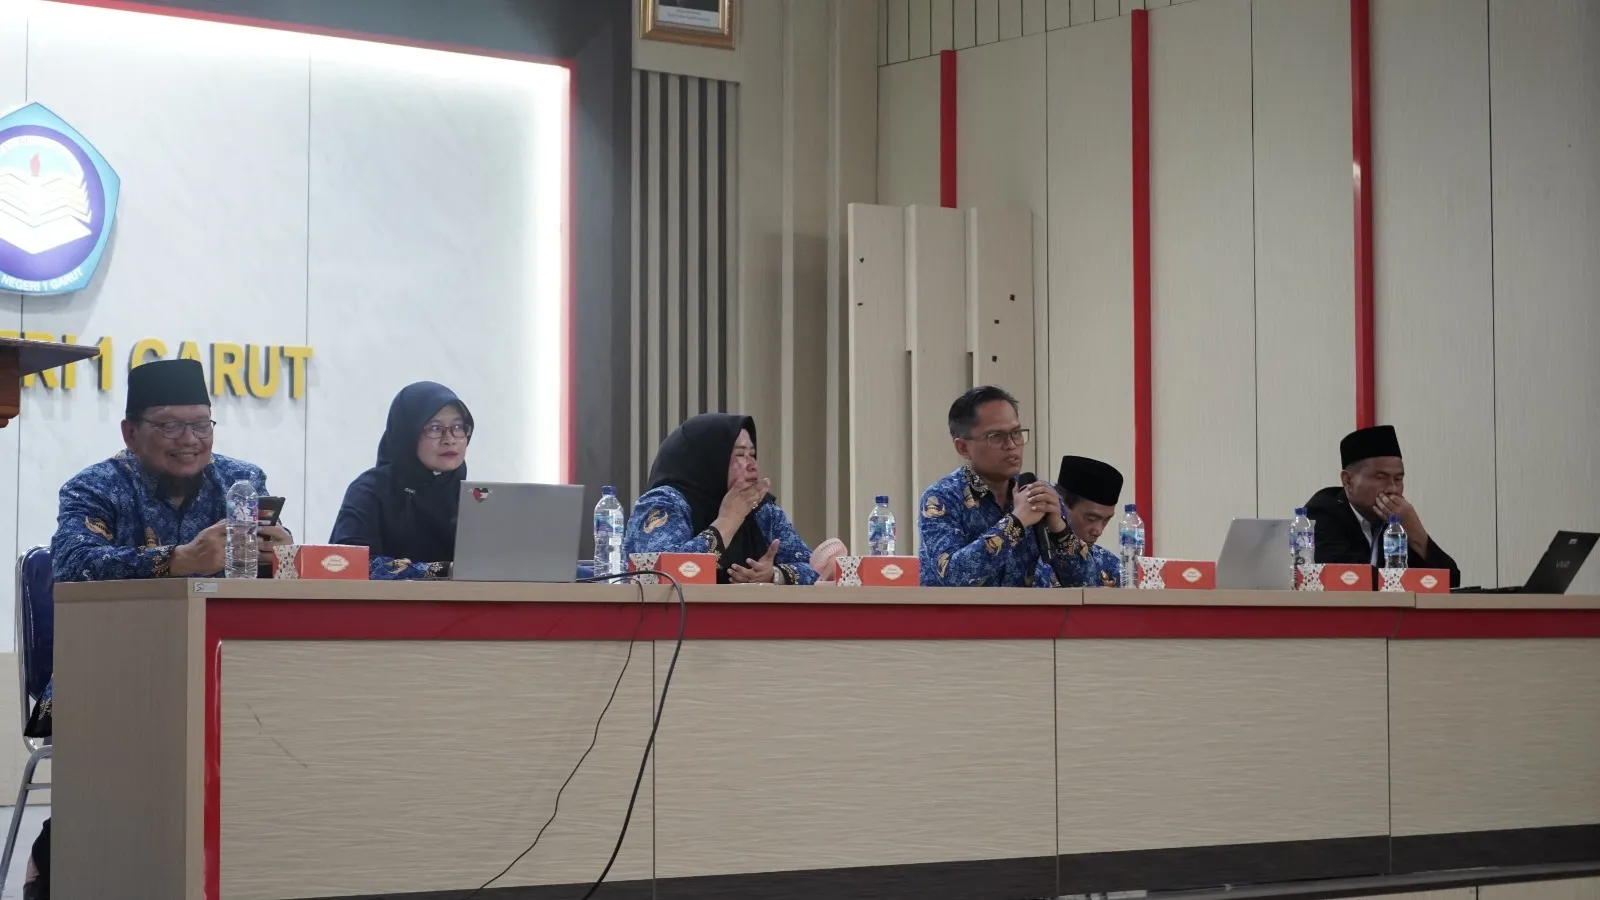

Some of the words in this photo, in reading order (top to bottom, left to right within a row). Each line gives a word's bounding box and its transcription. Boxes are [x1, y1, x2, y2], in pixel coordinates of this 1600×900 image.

[1, 273, 41, 292] NEGERI
[42, 281, 49, 291] 1
[50, 266, 84, 289] GARUT
[93, 336, 113, 391] 1
